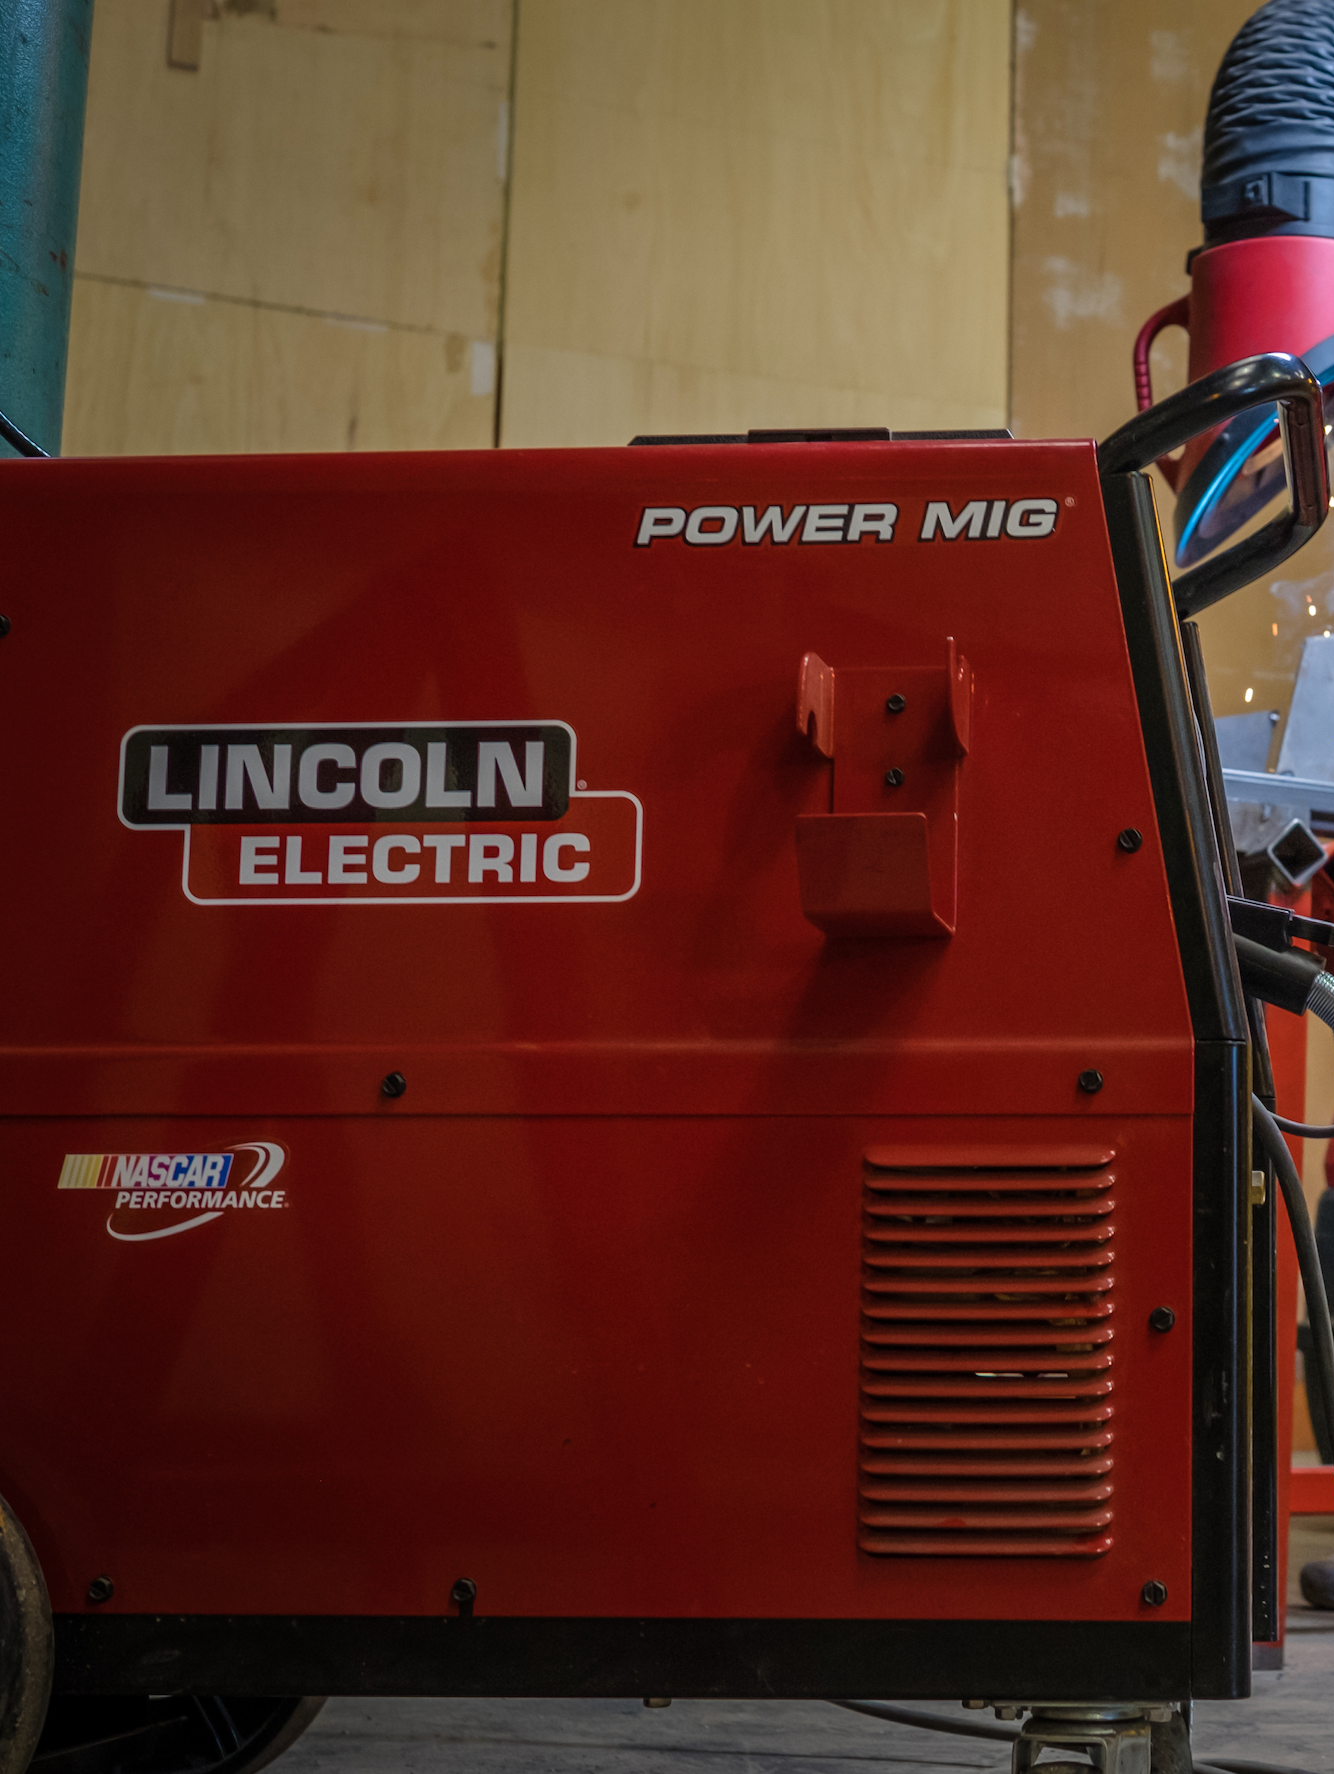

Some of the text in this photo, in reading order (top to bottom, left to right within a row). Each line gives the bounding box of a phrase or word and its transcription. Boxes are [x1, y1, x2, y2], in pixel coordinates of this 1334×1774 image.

[634, 497, 1060, 547] POWER MIG
[147, 740, 545, 811] LINCOLN
[238, 832, 591, 886] ELECTRIC
[112, 1154, 225, 1188] NASCAR
[115, 1190, 286, 1209] PERFORMANCE
